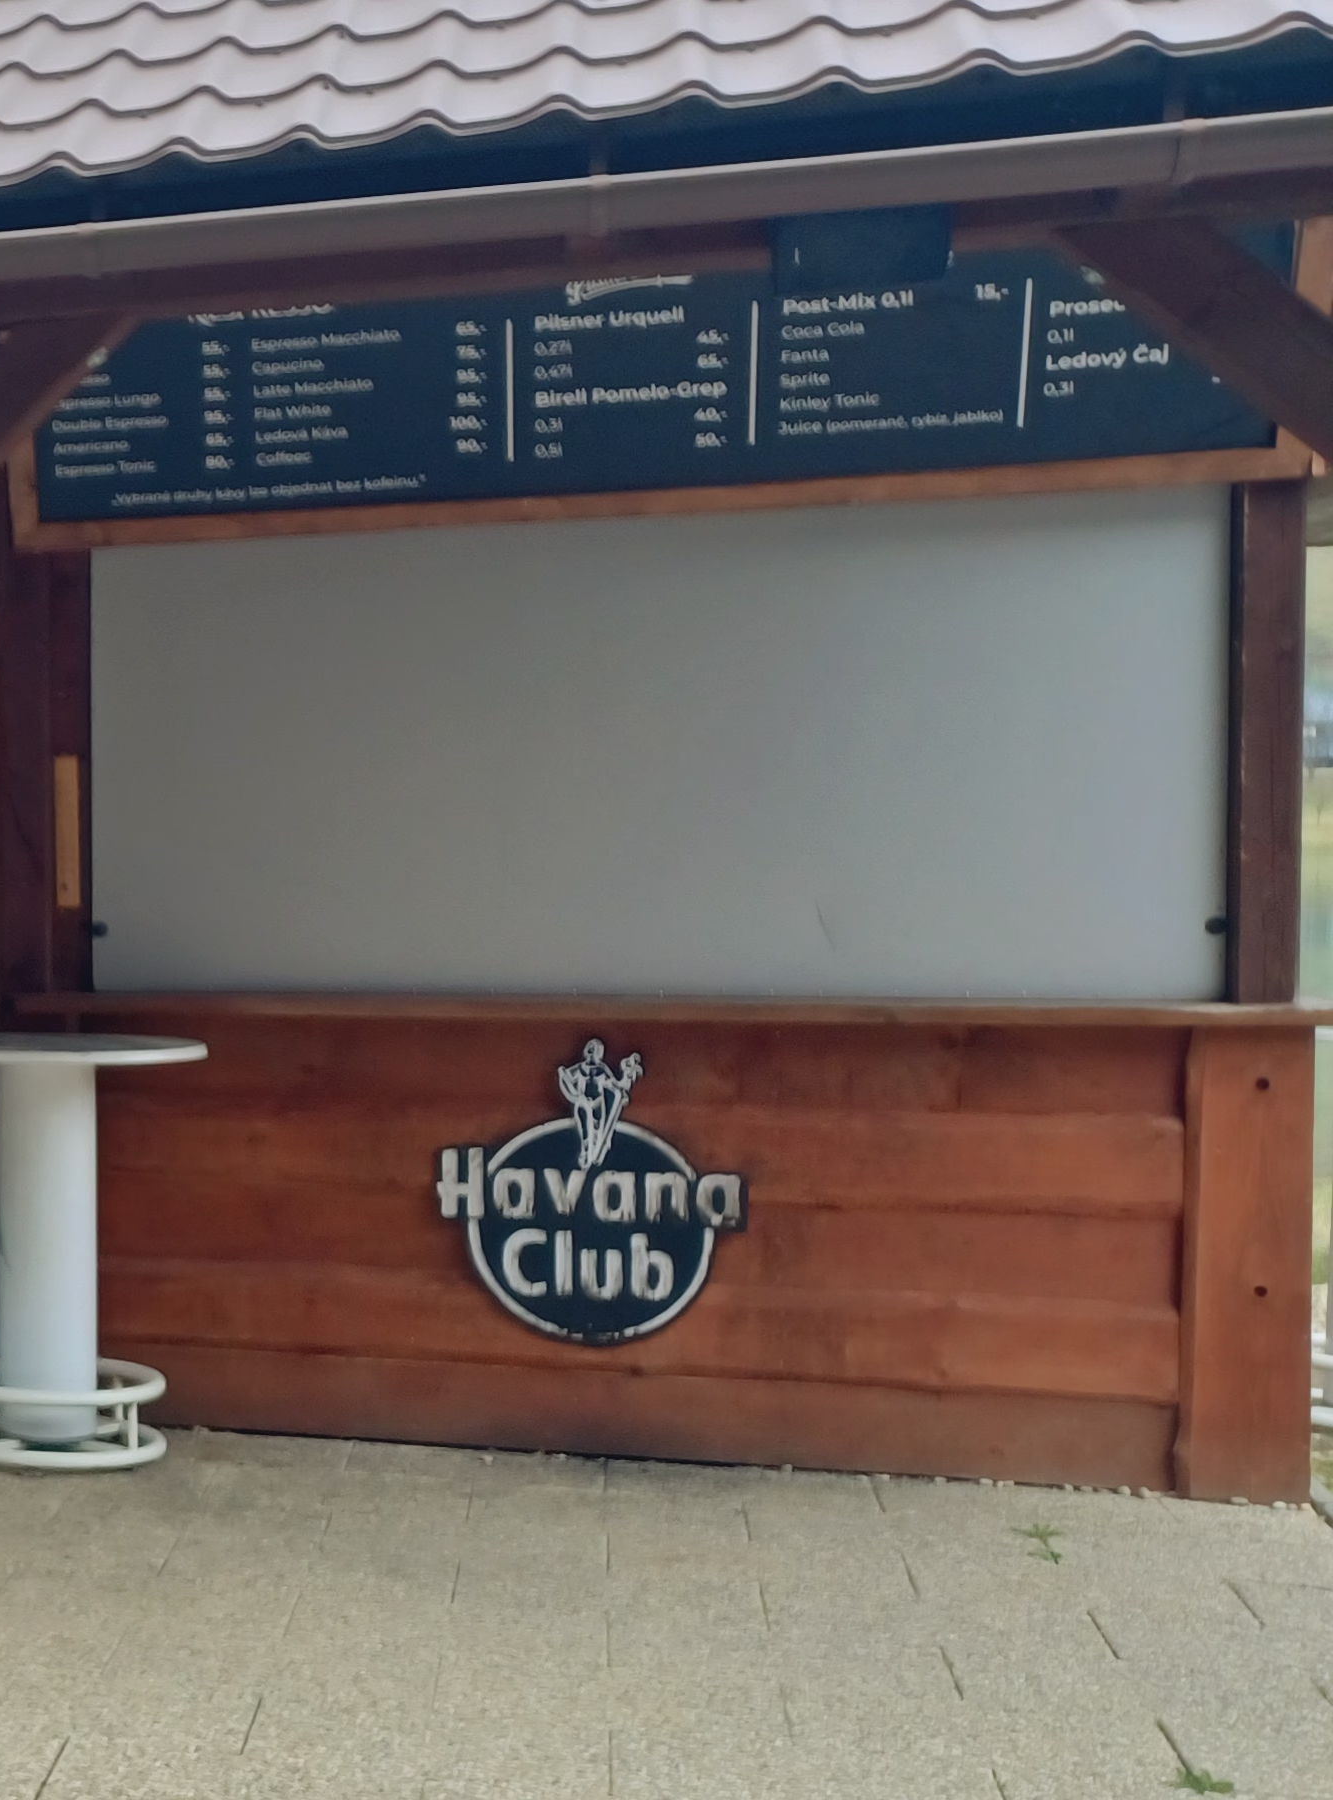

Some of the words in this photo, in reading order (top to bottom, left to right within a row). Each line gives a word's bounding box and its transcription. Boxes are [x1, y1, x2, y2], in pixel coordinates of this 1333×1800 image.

[783, 292, 876, 315] Post-Mix
[1050, 299, 1126, 318] Prose
[534, 313, 604, 332] Pilsner
[609, 305, 685, 328] Urquell
[251, 336, 318, 353] Espresso
[321, 328, 401, 346] Macchiato
[781, 323, 823, 341] Coca
[827, 320, 865, 337] Cola
[252, 358, 325, 376] Capucino
[780, 348, 830, 365] Fanta
[1046, 347, 1127, 371] Ledový
[1133, 342, 1169, 365] Čaj
[253, 382, 294, 399] Latte
[295, 377, 374, 396] Macchiato
[780, 372, 830, 391] Sprite
[53, 397, 111, 412] spresso
[114, 393, 162, 409] Lungo
[535, 387, 588, 408] Birell
[592, 381, 729, 405] Pomelo-Grep
[779, 396, 831, 413] Kinley
[834, 391, 880, 408] Tonic
[253, 405, 282, 421] Flat
[285, 401, 331, 418] White
[52, 417, 102, 434] Double
[105, 415, 169, 431] Espresso
[255, 426, 308, 443] Ledová
[311, 423, 349, 441] Káva
[778, 420, 823, 437] Juice
[53, 440, 130, 456] Americano
[55, 463, 115, 479] Espresso
[117, 458, 158, 473] Tonic
[436, 1147, 742, 1226] Havana
[501, 1227, 675, 1301] Club
